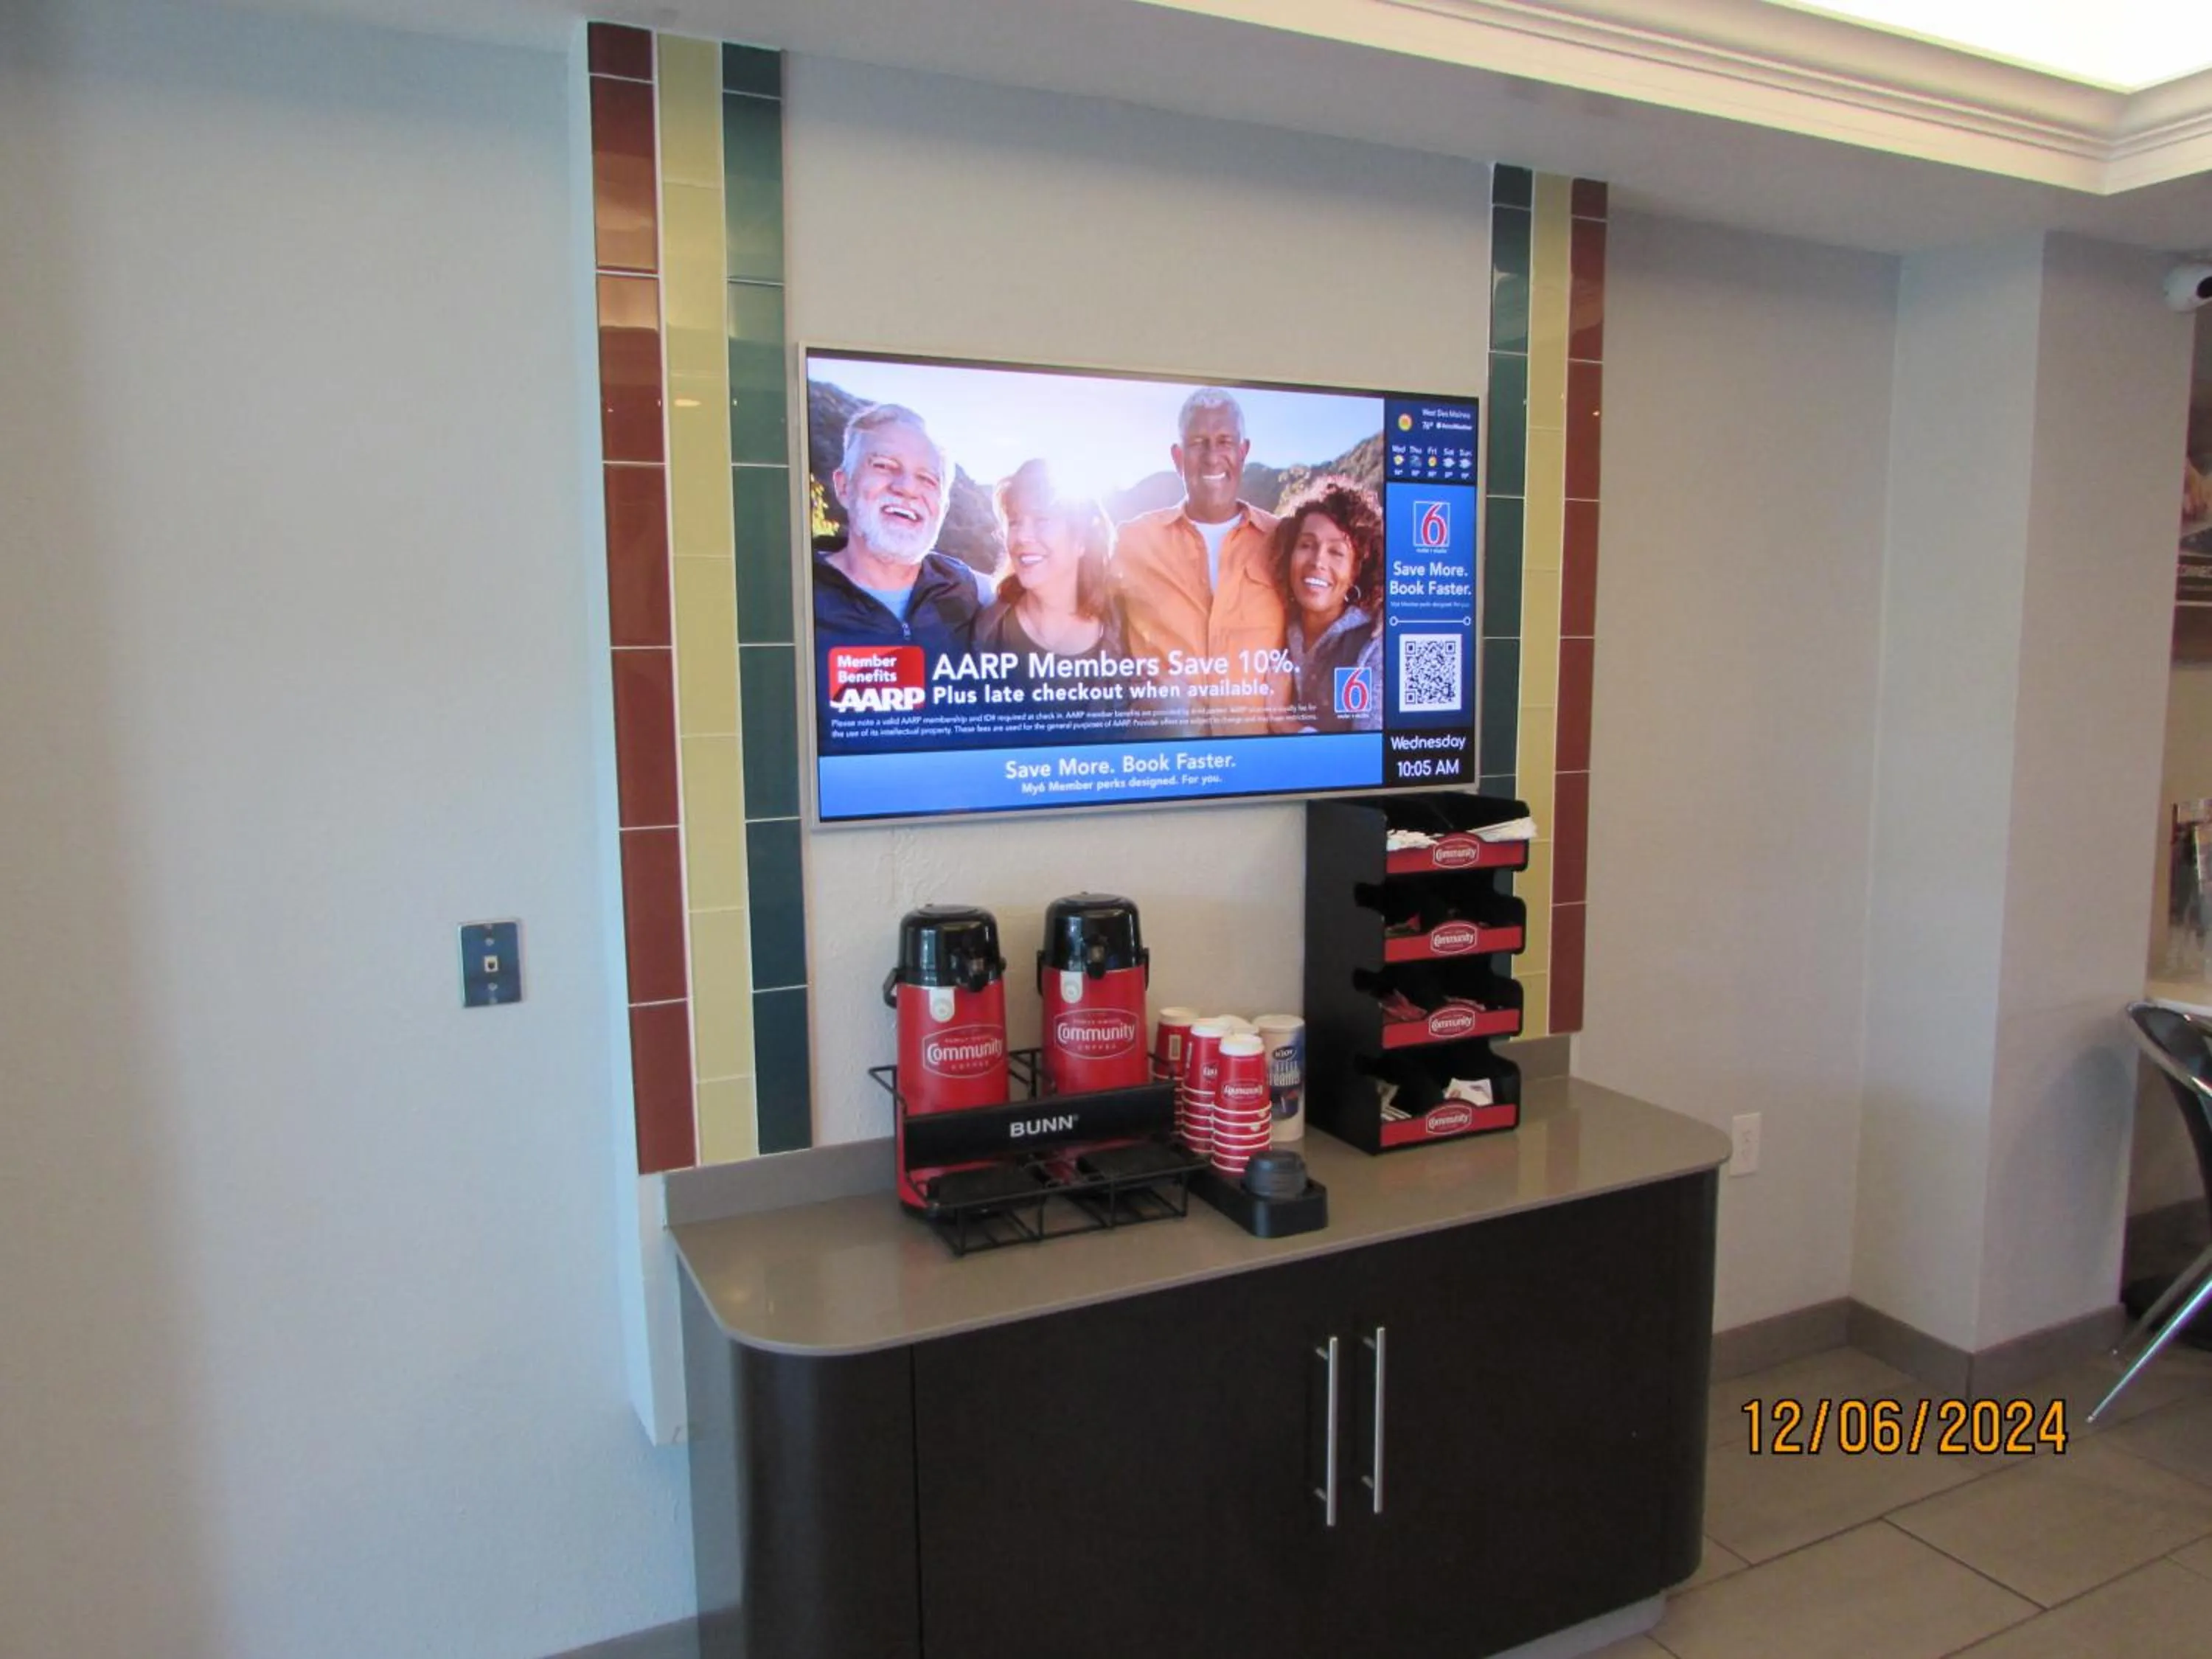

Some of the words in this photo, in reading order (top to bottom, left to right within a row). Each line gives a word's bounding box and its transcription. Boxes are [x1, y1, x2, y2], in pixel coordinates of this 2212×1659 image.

[1393, 560, 1425, 576] Save
[1430, 561, 1468, 577] More.
[1390, 580, 1425, 595] Book
[1429, 580, 1472, 596] Faster.
[837, 653, 897, 668] Member
[932, 653, 1018, 681] AARP
[1029, 650, 1160, 679] Members
[1168, 650, 1228, 676] Save
[1239, 648, 1301, 674] 10%.
[838, 669, 897, 684] Benefits
[830, 686, 926, 713] AARP
[933, 685, 977, 705] Plus
[985, 684, 1025, 703] late
[1032, 681, 1124, 702] checkout
[1129, 681, 1180, 699] when
[1187, 678, 1275, 698] available.
[1391, 734, 1467, 751] Wednesday
[1005, 760, 1051, 779] Save
[1059, 758, 1115, 776] More.
[1122, 753, 1170, 772] Book
[1176, 752, 1237, 770] Faster.
[1397, 759, 1431, 777] 10:05
[1436, 759, 1460, 775] AM
[1021, 782, 1045, 796] My6
[1048, 780, 1093, 793] Member
[1096, 779, 1126, 791] perks
[1129, 776, 1178, 790] designed.
[1182, 774, 1199, 785] For
[1202, 774, 1222, 785] you.
[1434, 931, 1474, 947] Community
[1058, 1022, 1135, 1045] Community
[1431, 1015, 1472, 1032] Community
[928, 1037, 1003, 1065] Community
[1009, 1114, 1073, 1138] BUNN
